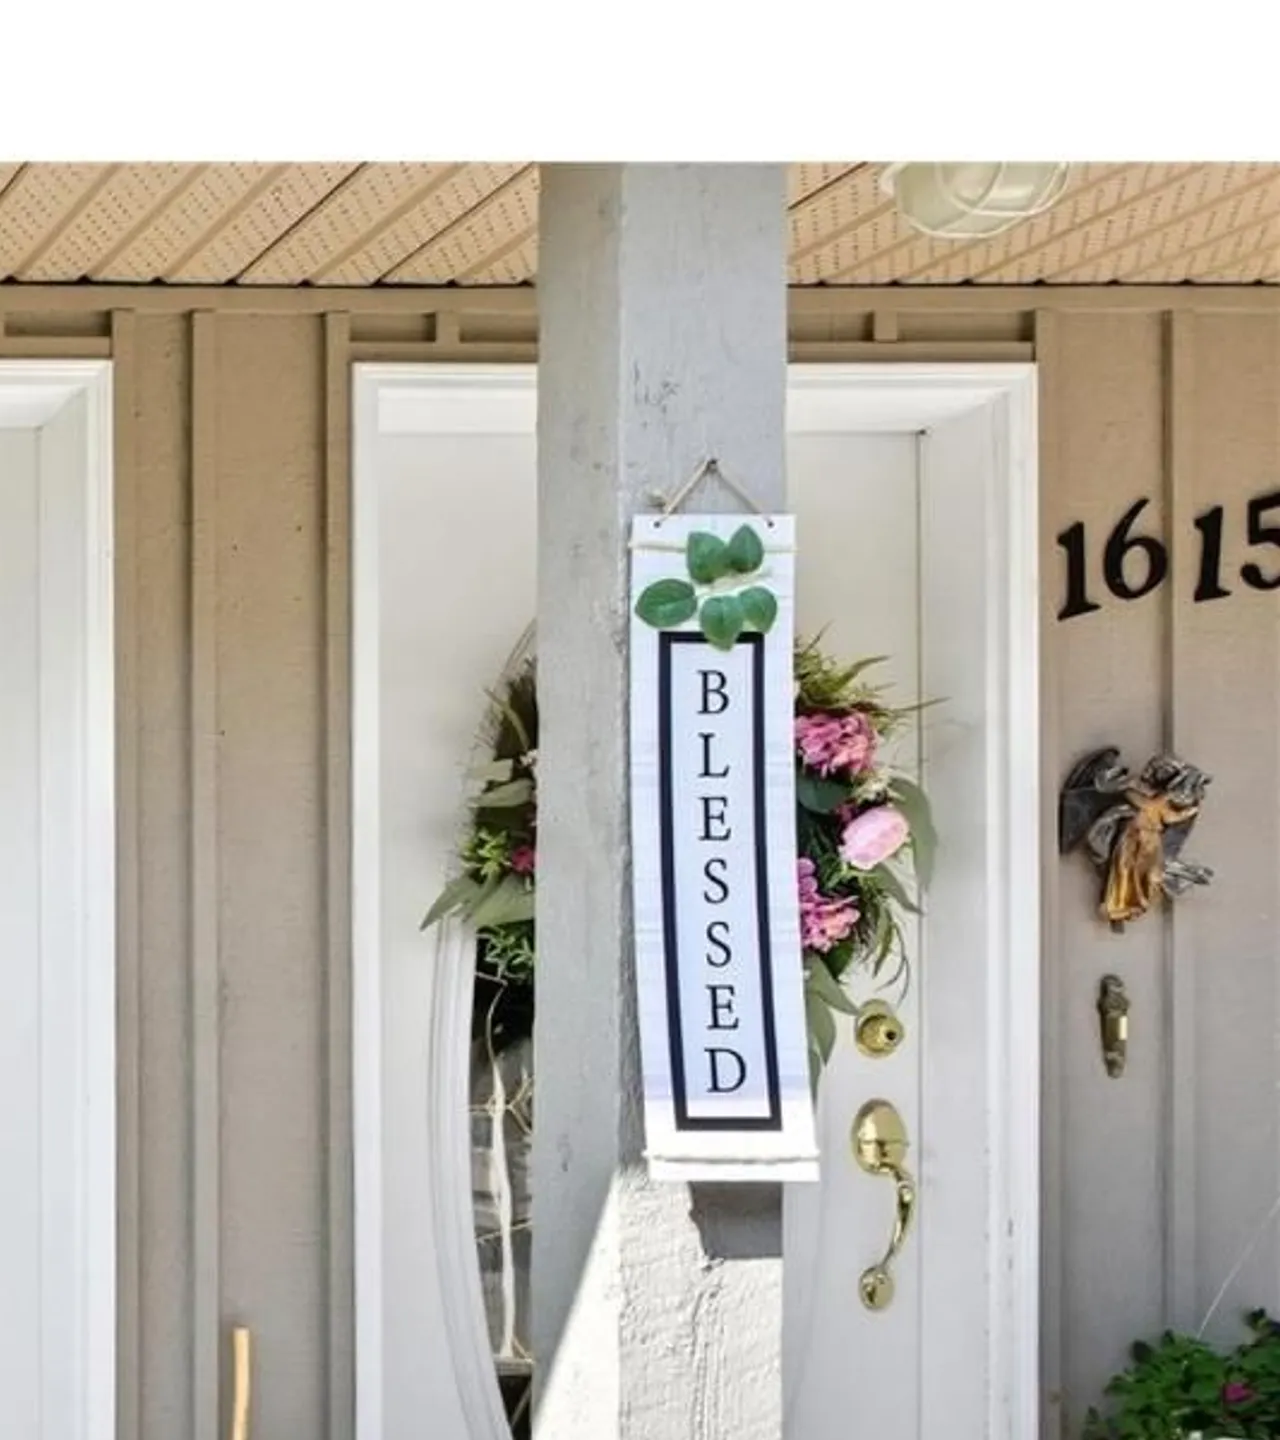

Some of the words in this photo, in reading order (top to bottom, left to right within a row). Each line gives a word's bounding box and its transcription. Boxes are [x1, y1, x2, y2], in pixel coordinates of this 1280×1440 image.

[1056, 496, 1169, 622] 16
[1192, 490, 1280, 602] 15
[695, 669, 748, 1096] BLESSED
